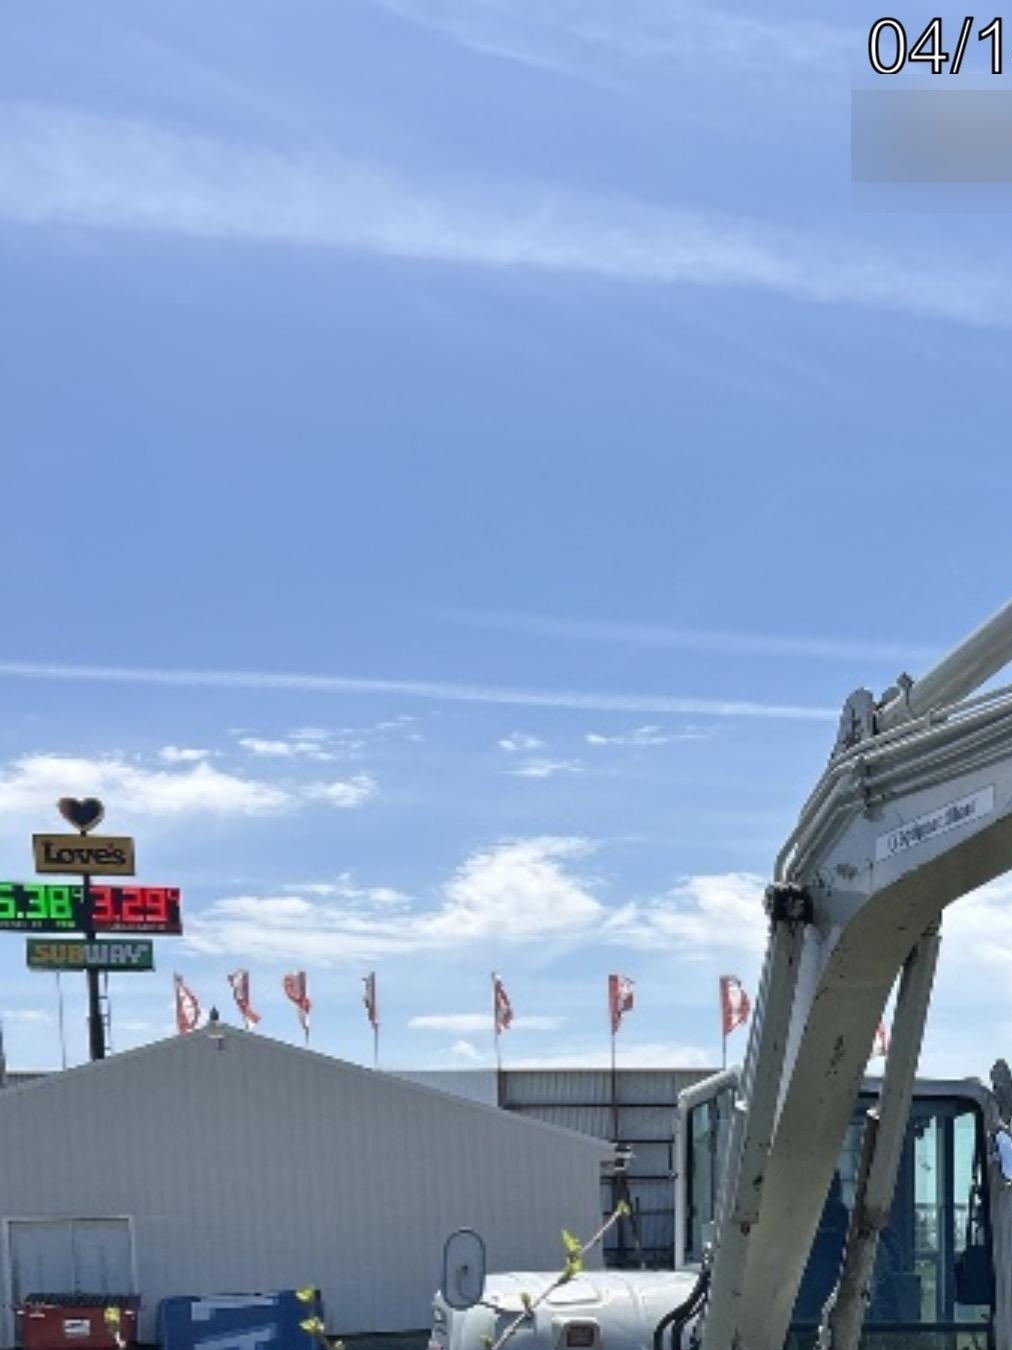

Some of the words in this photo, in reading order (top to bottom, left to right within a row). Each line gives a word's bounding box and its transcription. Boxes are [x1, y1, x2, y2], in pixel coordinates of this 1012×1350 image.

[42, 840, 126, 865] Love's
[91, 887, 168, 922] 3.29
[32, 943, 149, 964] SUBWAY
